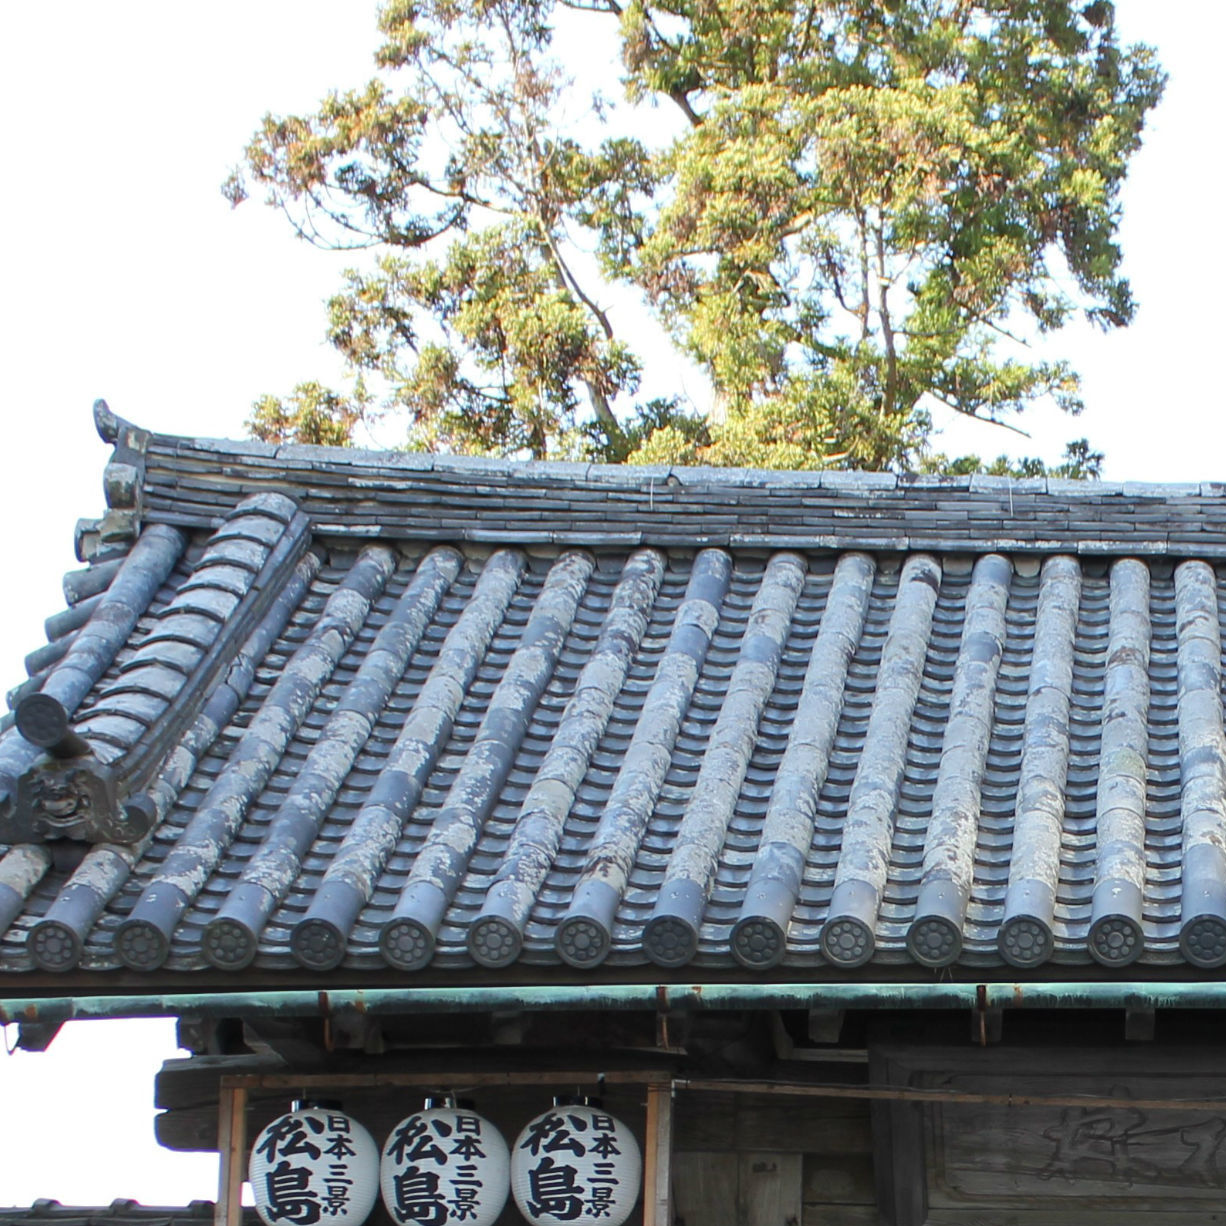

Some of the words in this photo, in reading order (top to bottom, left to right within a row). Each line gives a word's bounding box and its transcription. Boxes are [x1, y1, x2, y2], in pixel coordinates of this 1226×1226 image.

[256, 1113, 324, 1226] 松島
[321, 1114, 357, 1217] 日本三景
[387, 1115, 453, 1226] 松島
[449, 1115, 486, 1221] 日本三景
[520, 1112, 587, 1221] 松島
[586, 1113, 621, 1218] 日本三景
